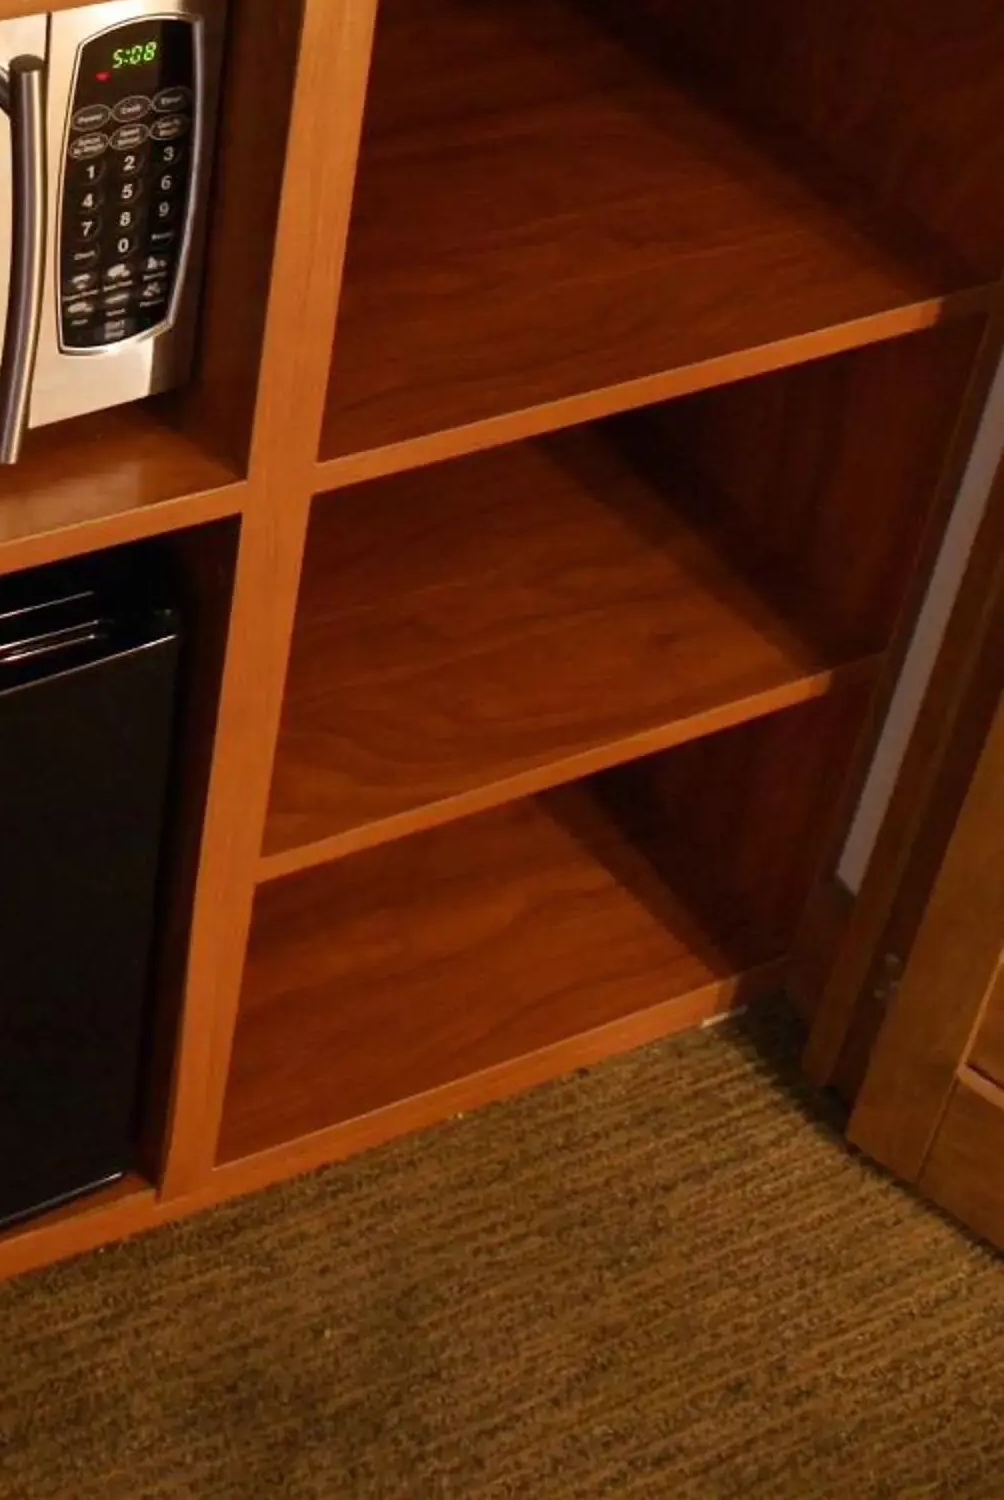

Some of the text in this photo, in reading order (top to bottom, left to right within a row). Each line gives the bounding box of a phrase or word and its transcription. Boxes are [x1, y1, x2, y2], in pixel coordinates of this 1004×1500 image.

[112, 41, 157, 69] 5:08
[163, 146, 174, 161] 3
[123, 155, 135, 171] 2
[86, 165, 95, 179] 1
[121, 183, 133, 199] 5
[161, 175, 172, 191] 6
[81, 193, 93, 207] 4
[159, 201, 170, 217] 9
[119, 211, 131, 227] 8
[82, 221, 93, 236] 7
[117, 238, 129, 253] 0
